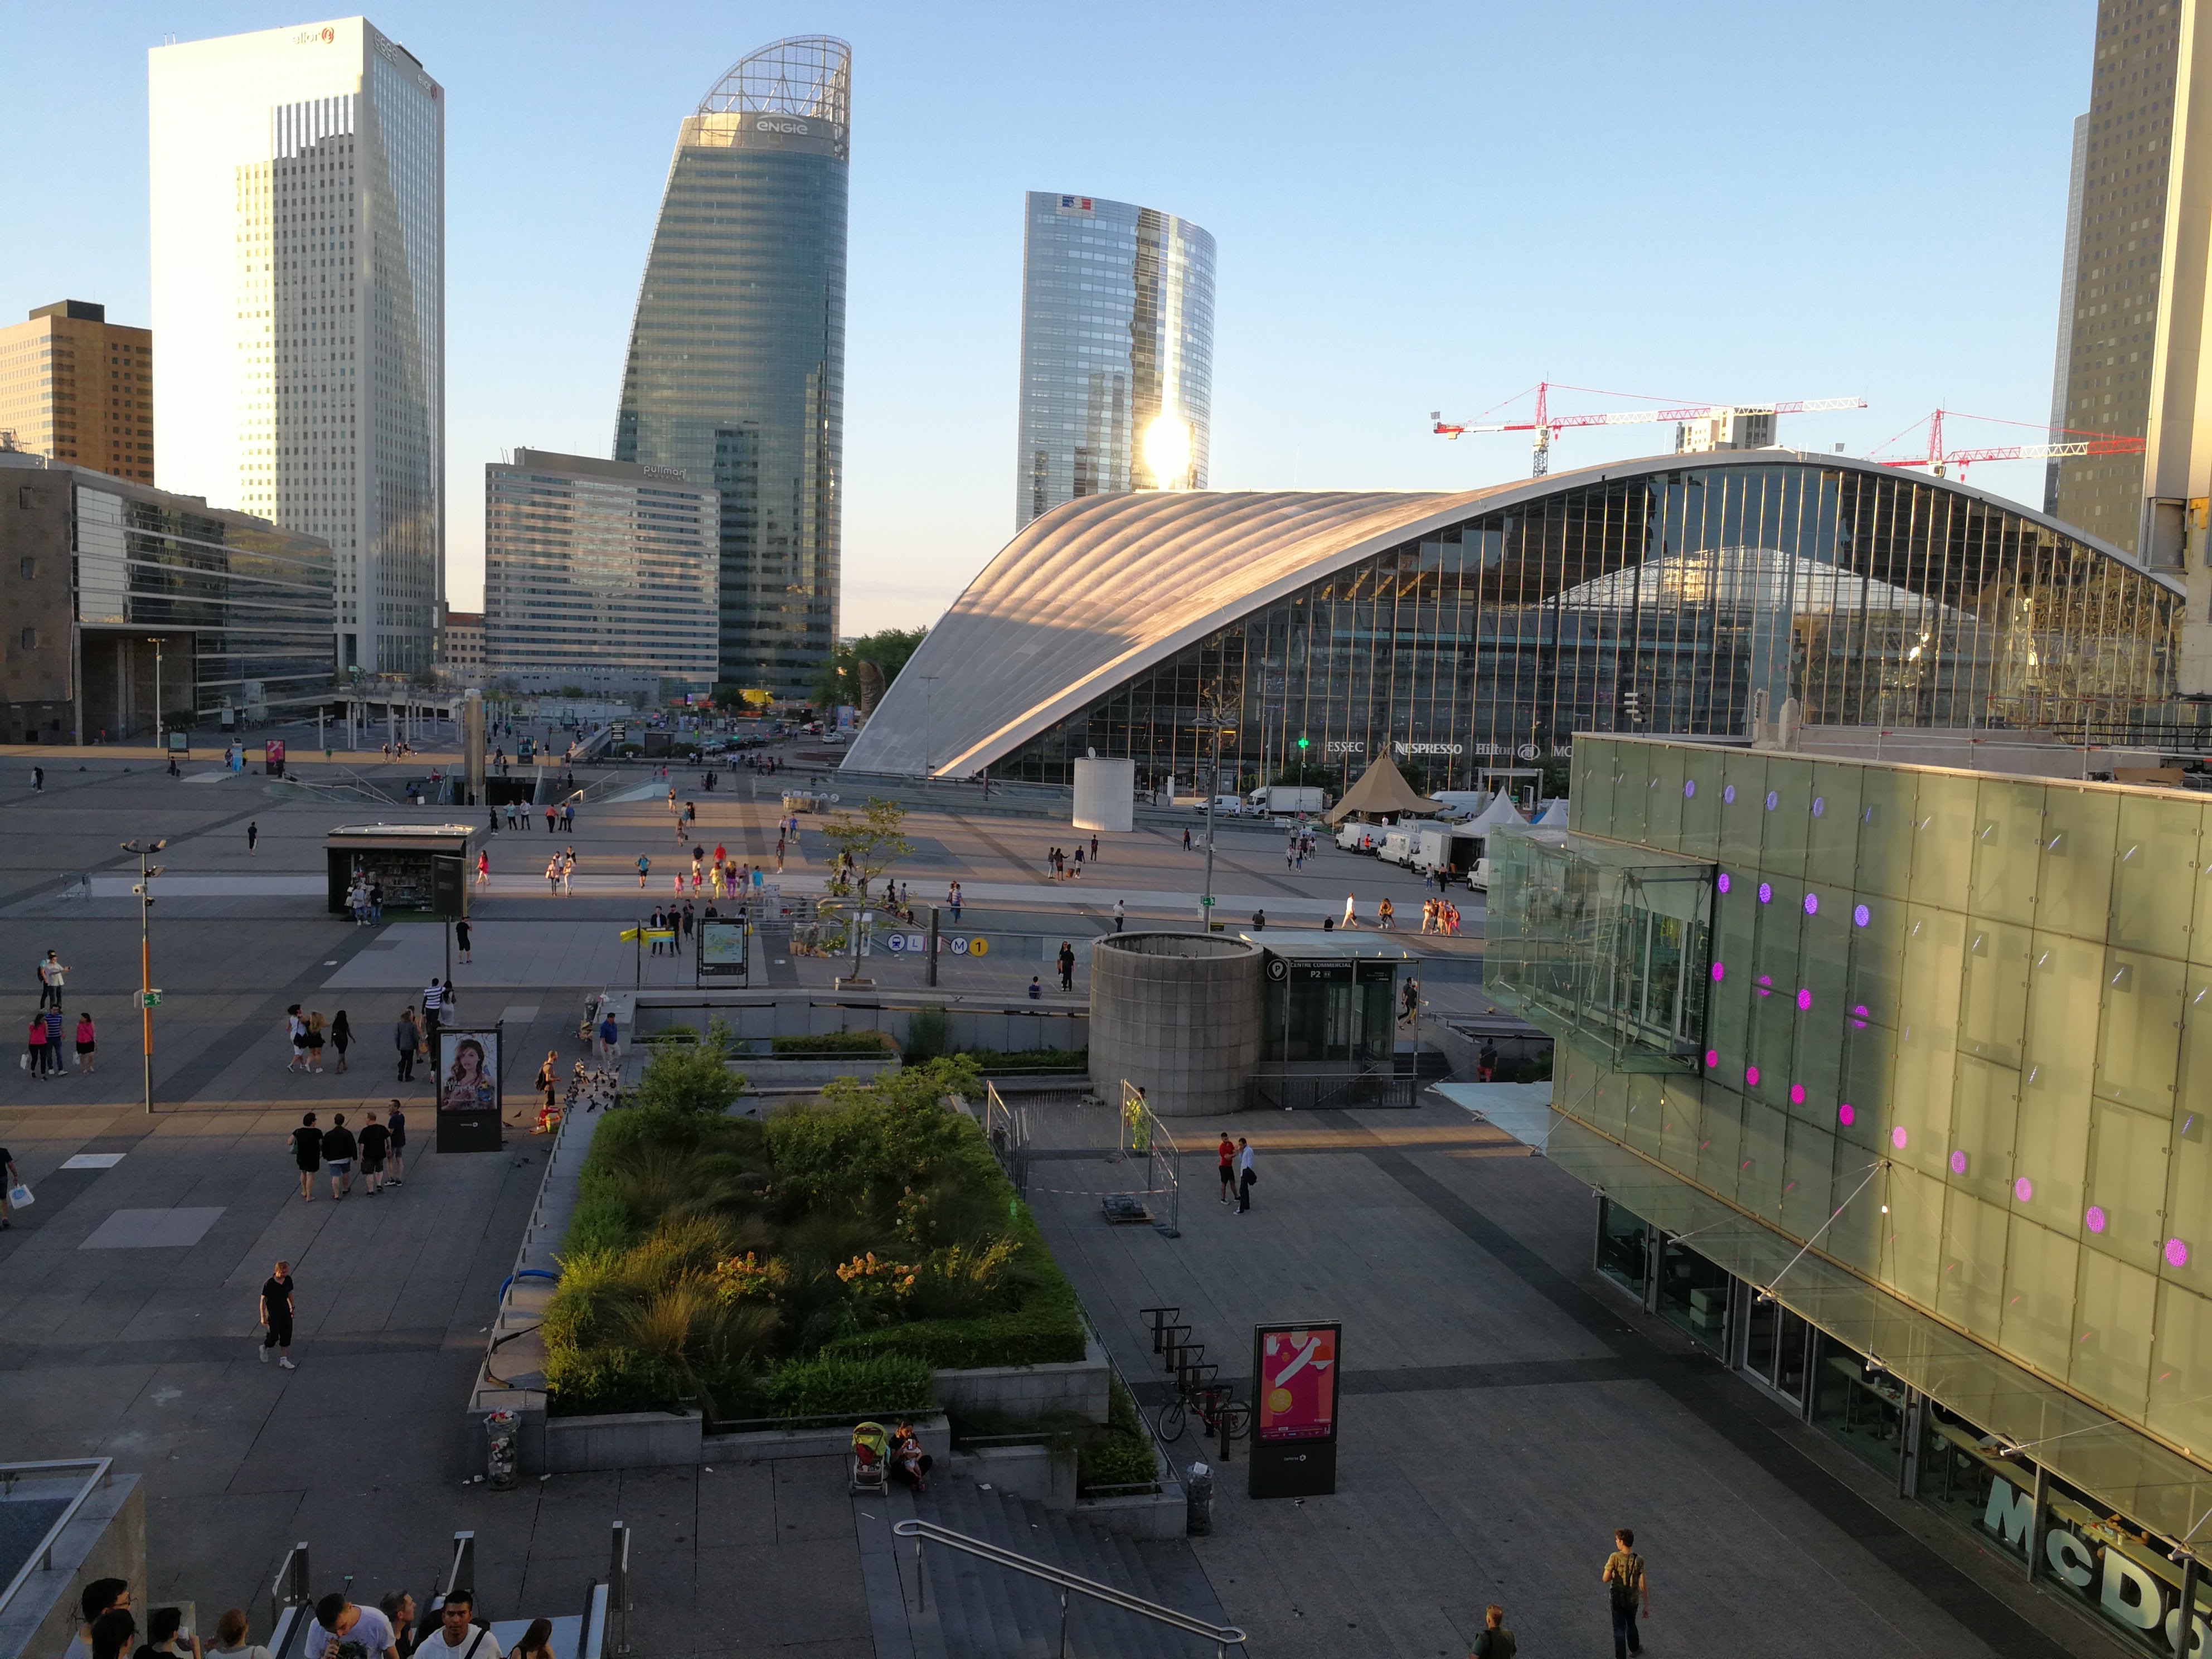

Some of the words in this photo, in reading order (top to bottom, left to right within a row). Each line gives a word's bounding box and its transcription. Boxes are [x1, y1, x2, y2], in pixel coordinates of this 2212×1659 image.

[292, 32, 320, 45] elior
[418, 74, 431, 91] elior
[644, 465, 686, 479] pullman
[1327, 741, 1365, 753] ESSEC
[1393, 740, 1463, 755] NESPRESSO
[1475, 743, 1515, 755] Hilton
[912, 939, 918, 947] L
[954, 942, 964, 950] M
[976, 942, 981, 952] 1
